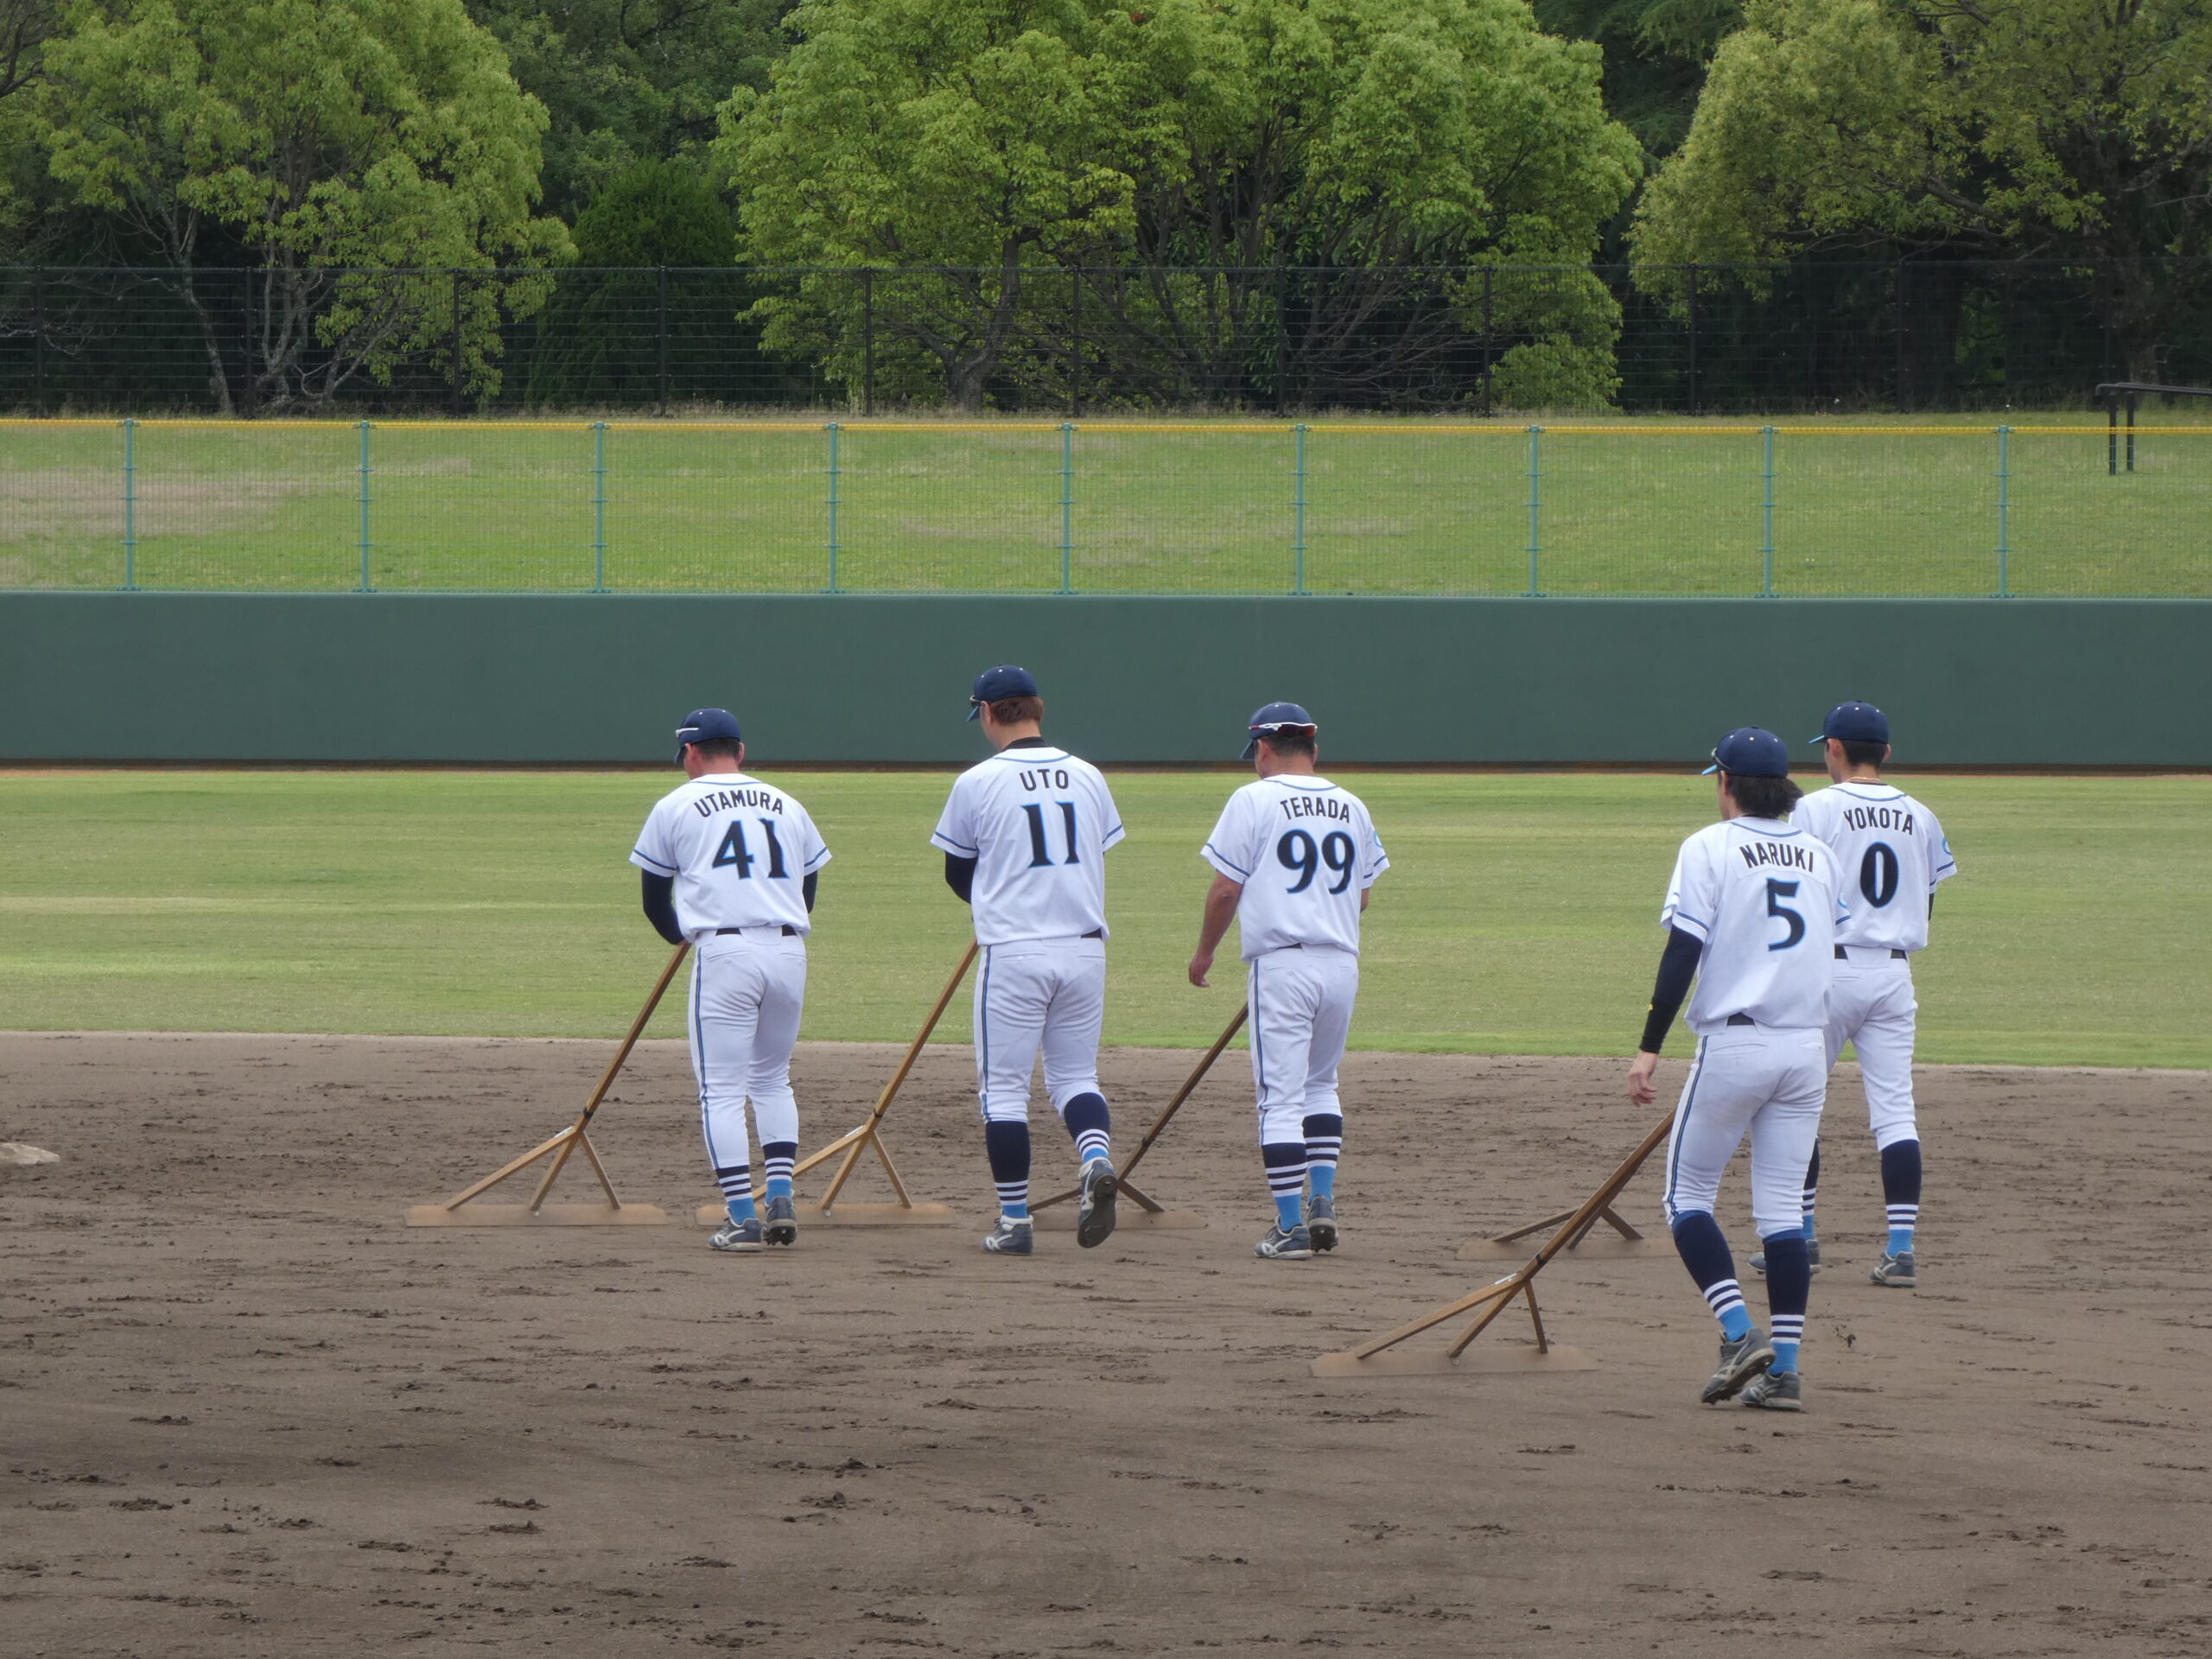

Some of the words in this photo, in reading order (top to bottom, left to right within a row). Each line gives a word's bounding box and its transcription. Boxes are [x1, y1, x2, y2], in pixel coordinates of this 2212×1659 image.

[1019, 768, 1069, 791] UTO
[694, 789, 783, 817] UTAMURA
[1280, 796, 1351, 823] TERADA
[1843, 806, 1914, 836] YOKOTA
[711, 818, 790, 880] 41
[1019, 800, 1081, 869] 11
[1738, 842, 1814, 873] NARUKI
[1276, 828, 1356, 895] 99
[1859, 841, 1899, 908] 0
[1765, 876, 1806, 951] 5
